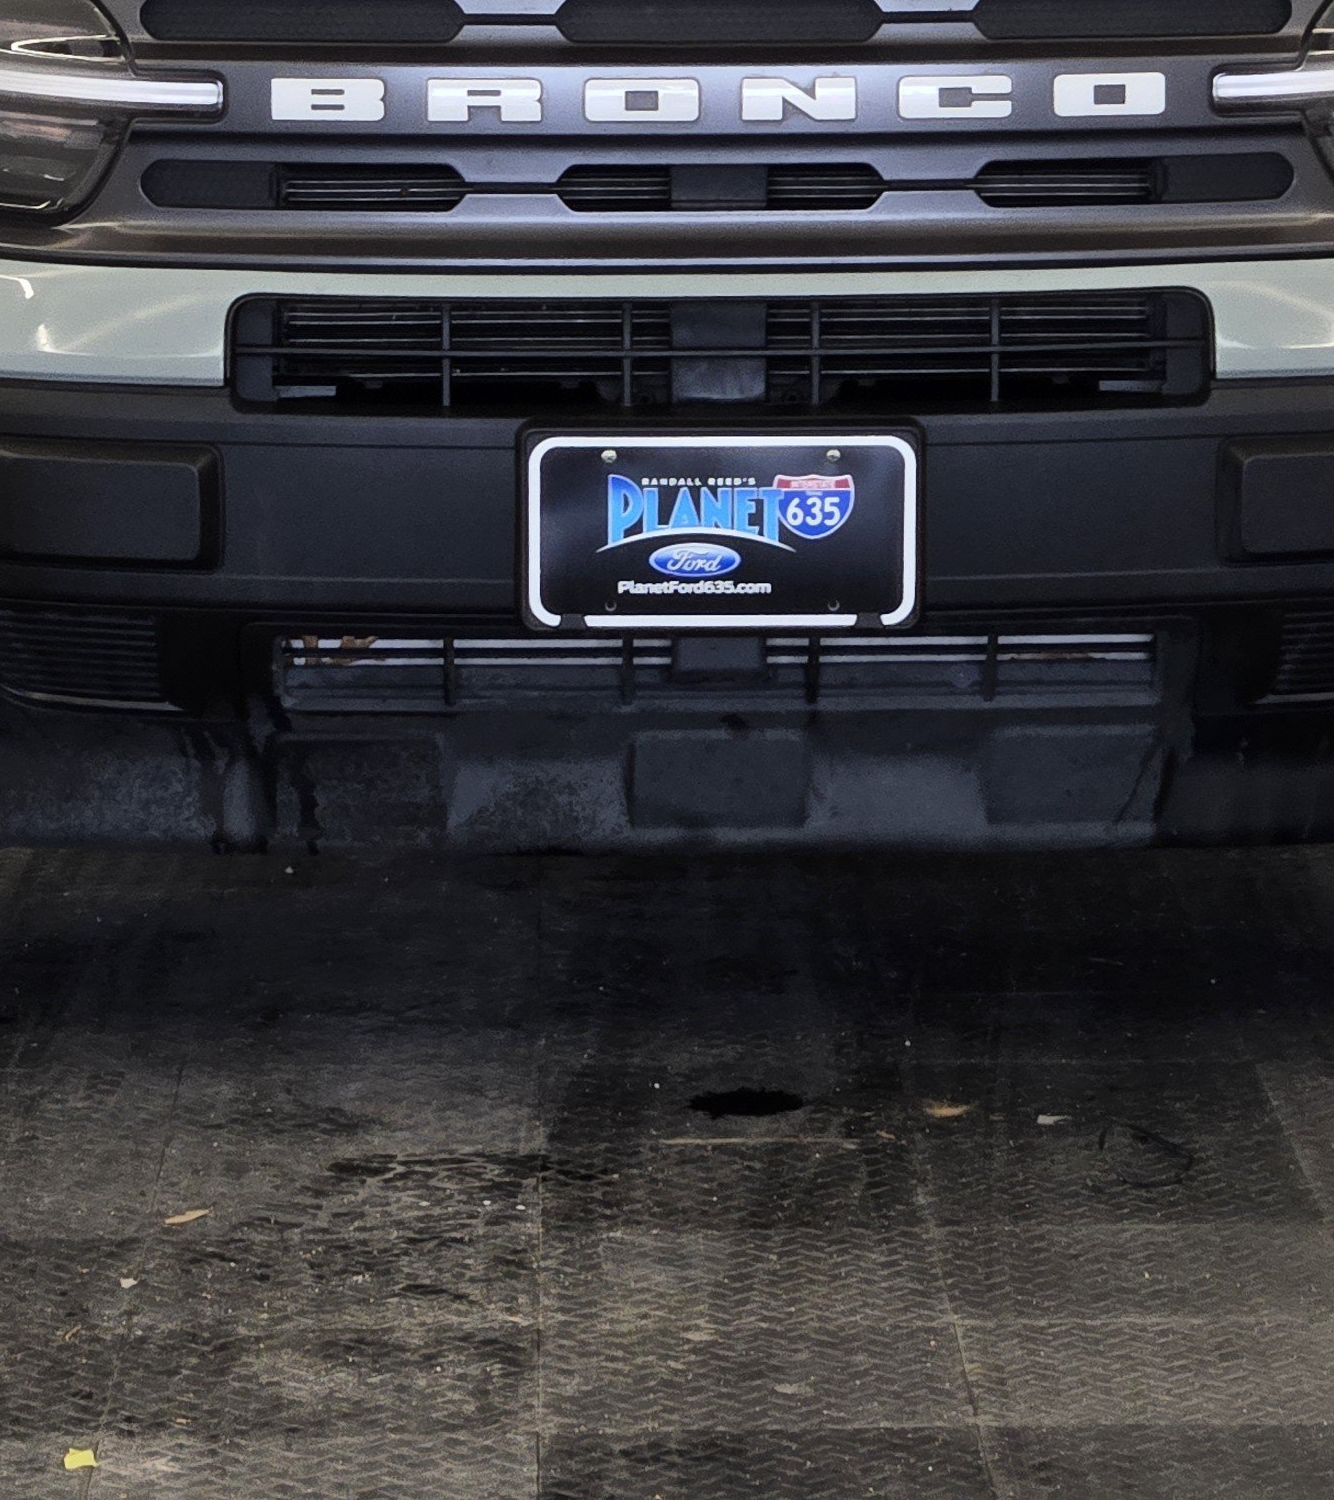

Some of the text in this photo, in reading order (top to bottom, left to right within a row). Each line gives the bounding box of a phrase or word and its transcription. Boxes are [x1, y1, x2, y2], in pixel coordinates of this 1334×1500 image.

[270, 71, 1166, 122] BRONCO
[608, 474, 784, 546] PLANET
[786, 496, 841, 526] 635
[667, 549, 721, 572] Ford
[617, 580, 772, 594] PlanetFord635.com
